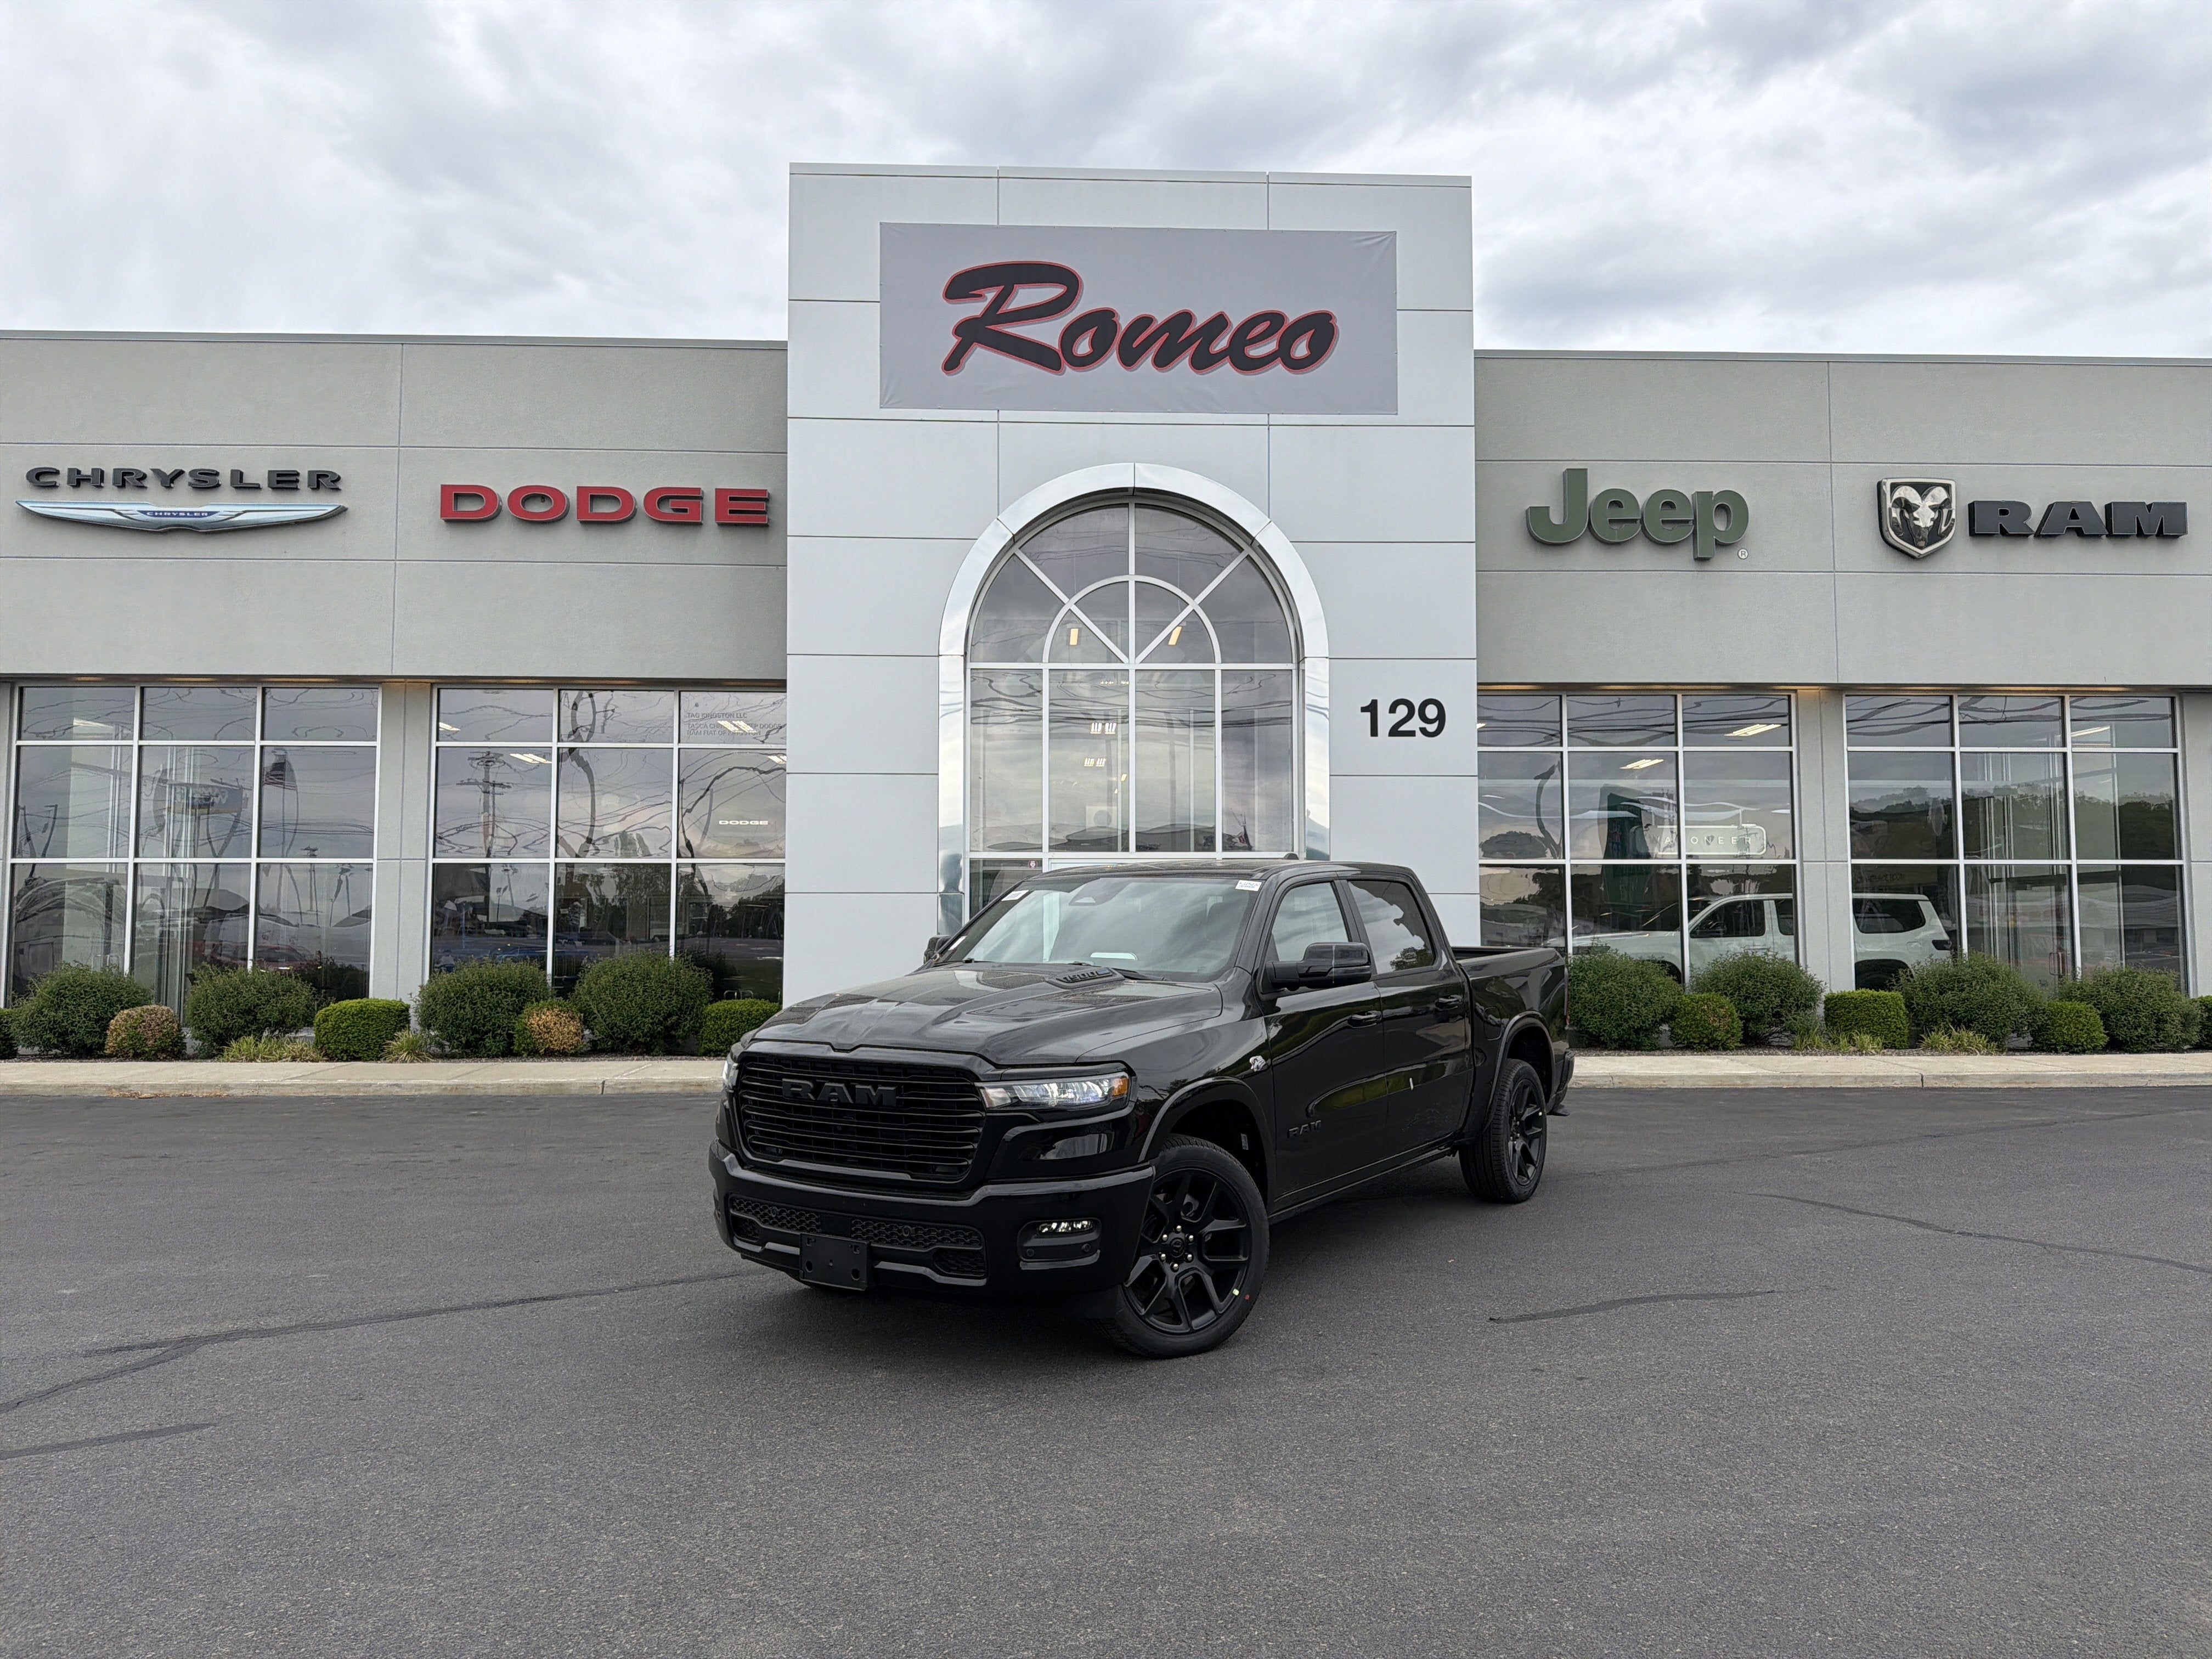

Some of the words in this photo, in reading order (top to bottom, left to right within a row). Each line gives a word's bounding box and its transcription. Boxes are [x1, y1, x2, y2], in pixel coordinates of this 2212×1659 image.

[942, 260, 1339, 375] Romeo
[26, 467, 342, 490] CHRYSLER
[440, 484, 770, 525] DODGE
[1526, 468, 1749, 560] Jeep
[1968, 500, 2188, 537] RAM
[1361, 698, 1446, 738] 129
[1654, 836, 1752, 845] AONEER
[782, 1078, 896, 1107] RAM
[1287, 1120, 1322, 1138] RAM
